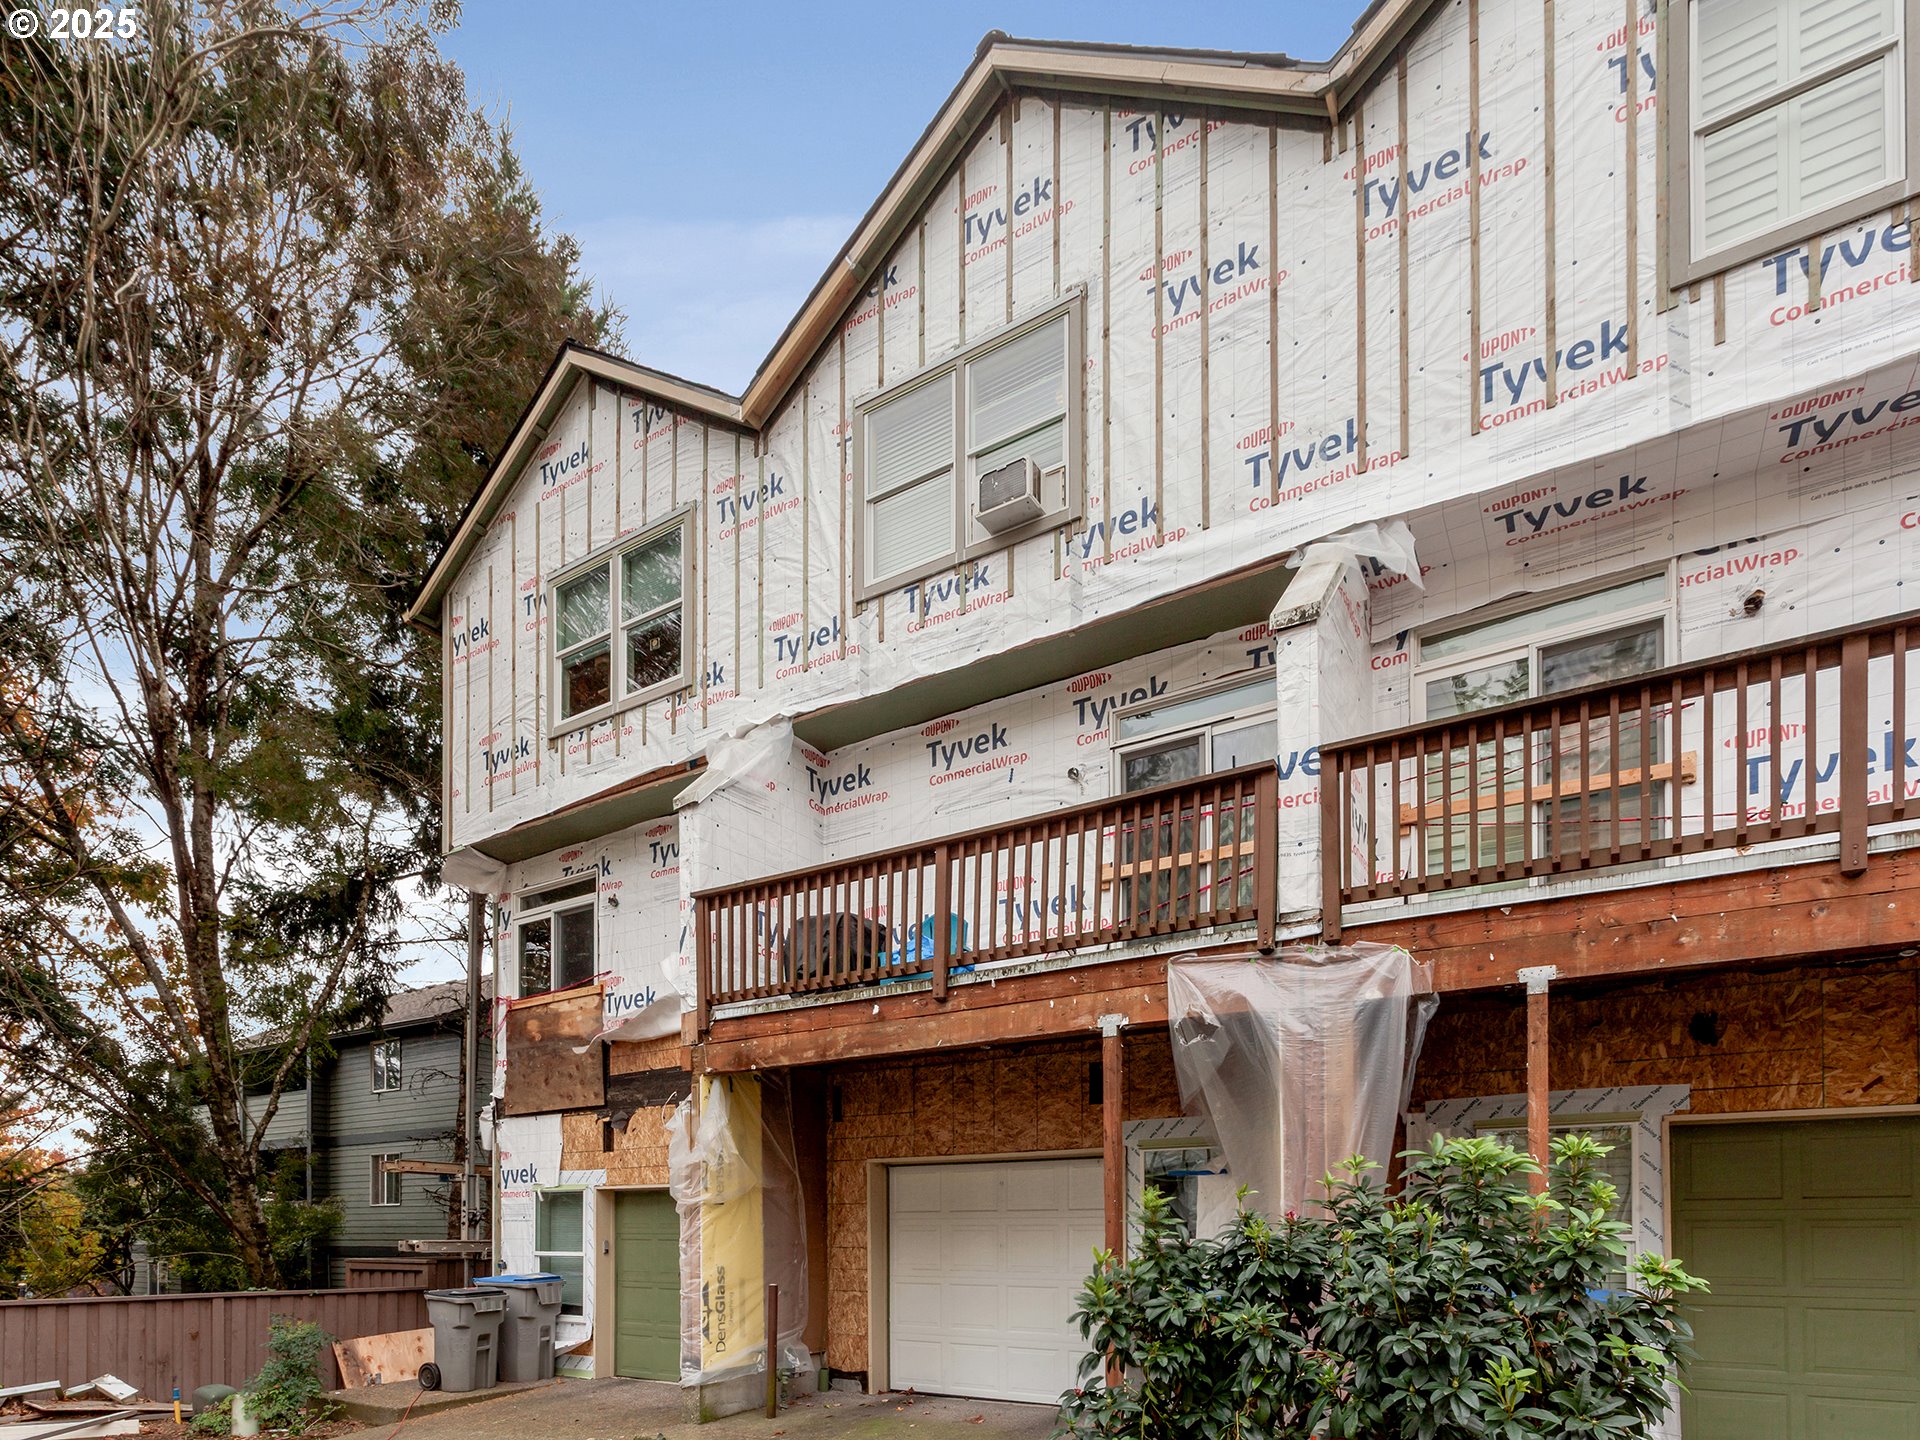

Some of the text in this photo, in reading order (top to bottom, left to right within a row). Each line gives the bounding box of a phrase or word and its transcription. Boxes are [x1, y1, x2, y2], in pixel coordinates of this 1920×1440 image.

[1353, 131, 1492, 218] Tyvek
[963, 176, 1053, 245] Tyvek
[964, 185, 994, 212] UPONT
[1762, 217, 1912, 295] Tyve
[1480, 319, 1629, 405] Tyvek
[1481, 328, 1527, 359] UPONT
[1779, 390, 1920, 448] Tyve
[1782, 388, 1855, 419] DUPONT
[1244, 418, 1370, 489] Tyvek
[1780, 416, 1920, 464] Commercia
[540, 442, 590, 487] Tyvek
[717, 472, 784, 524] Tyvek
[1492, 488, 1548, 513] DUPONT
[1494, 474, 1647, 534] Tyvek
[1505, 488, 1686, 547] CommercialWrap
[1679, 548, 1799, 588] ercialWrap
[453, 618, 489, 657] yvek
[772, 613, 801, 632] DUPONT
[773, 615, 848, 665] Tyvek
[1072, 672, 1107, 693] DUPONT
[925, 719, 956, 737] DUPONT
[926, 722, 1008, 771] Tyvek
[483, 736, 530, 774] Tyvek
[929, 752, 1028, 787] CommercialWrap
[805, 763, 871, 804] Tyvek
[808, 791, 889, 816] CommercialWrap
[649, 840, 680, 868] Tyv
[605, 986, 656, 1018] Tyvek
[501, 1163, 538, 1189] yvek
[715, 1266, 726, 1352] DensGlass
